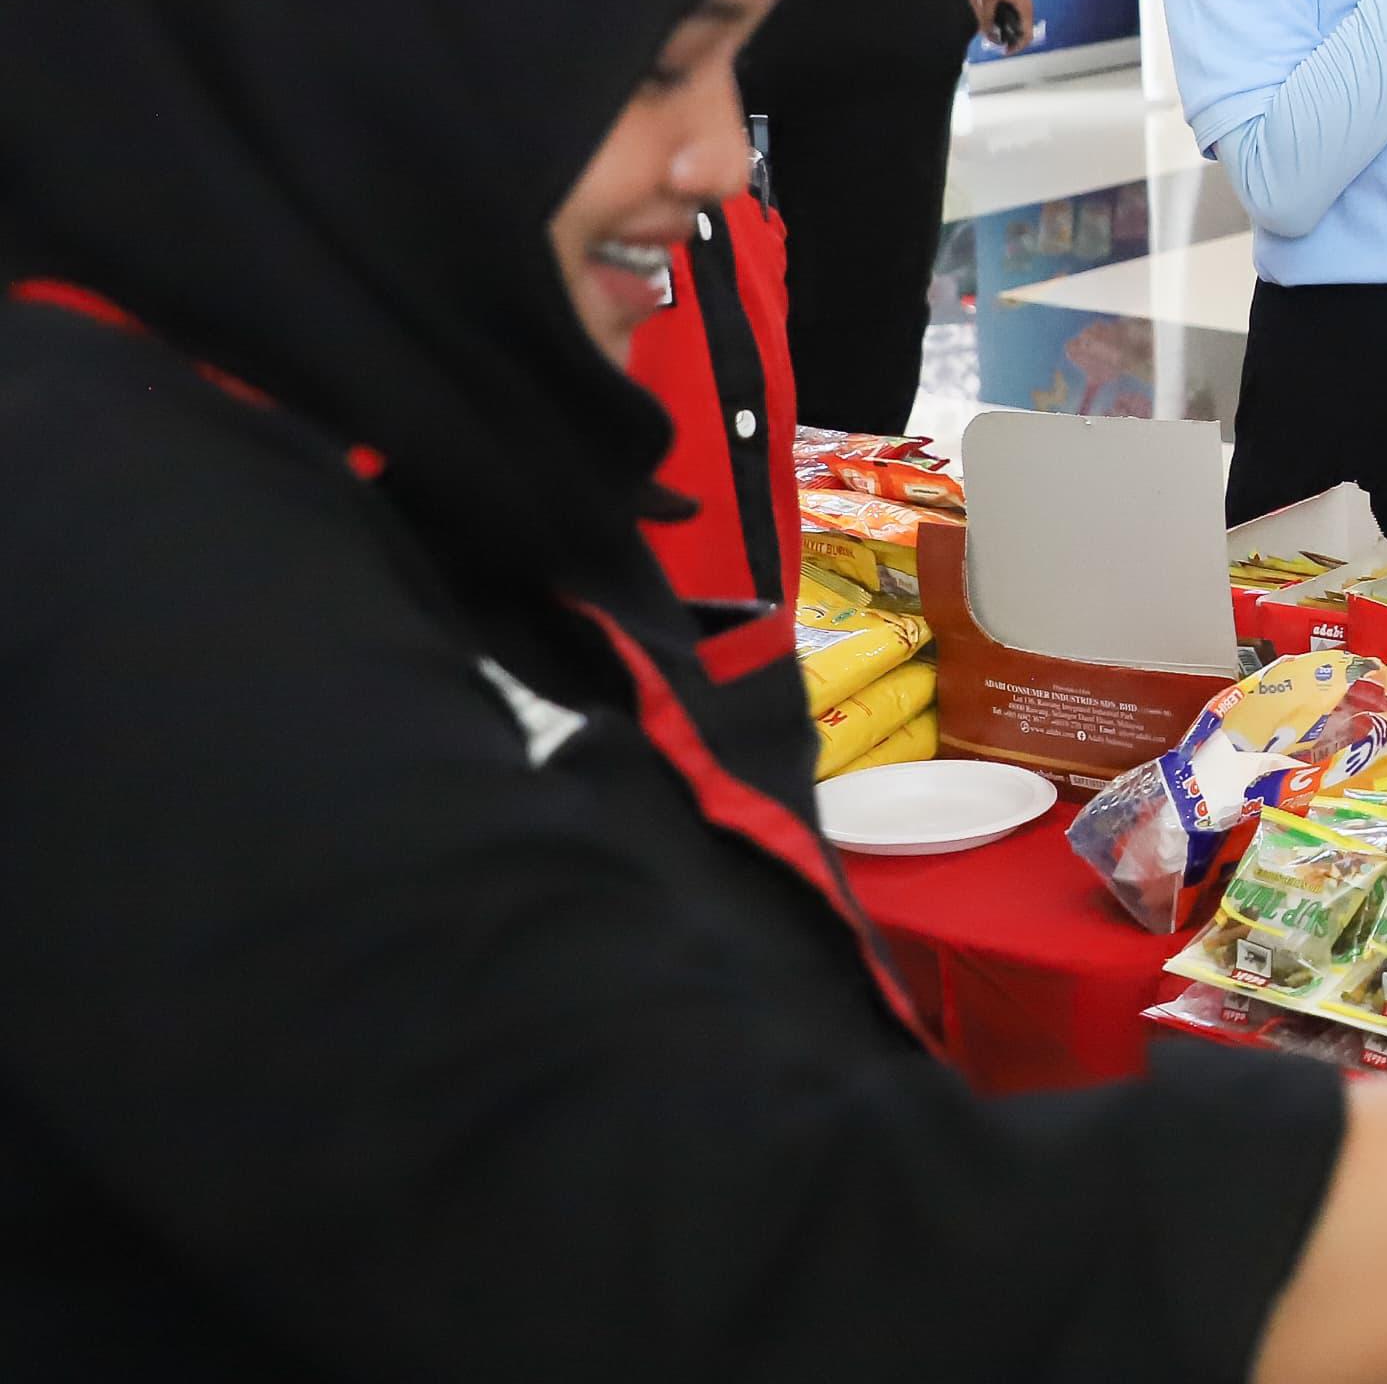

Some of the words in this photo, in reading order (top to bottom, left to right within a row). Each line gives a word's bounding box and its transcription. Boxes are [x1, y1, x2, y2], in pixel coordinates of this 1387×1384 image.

[1312, 623, 1344, 639] adabi
[1006, 683, 1050, 699] CONSUMER
[1051, 691, 1099, 706] INDUSTRIES
